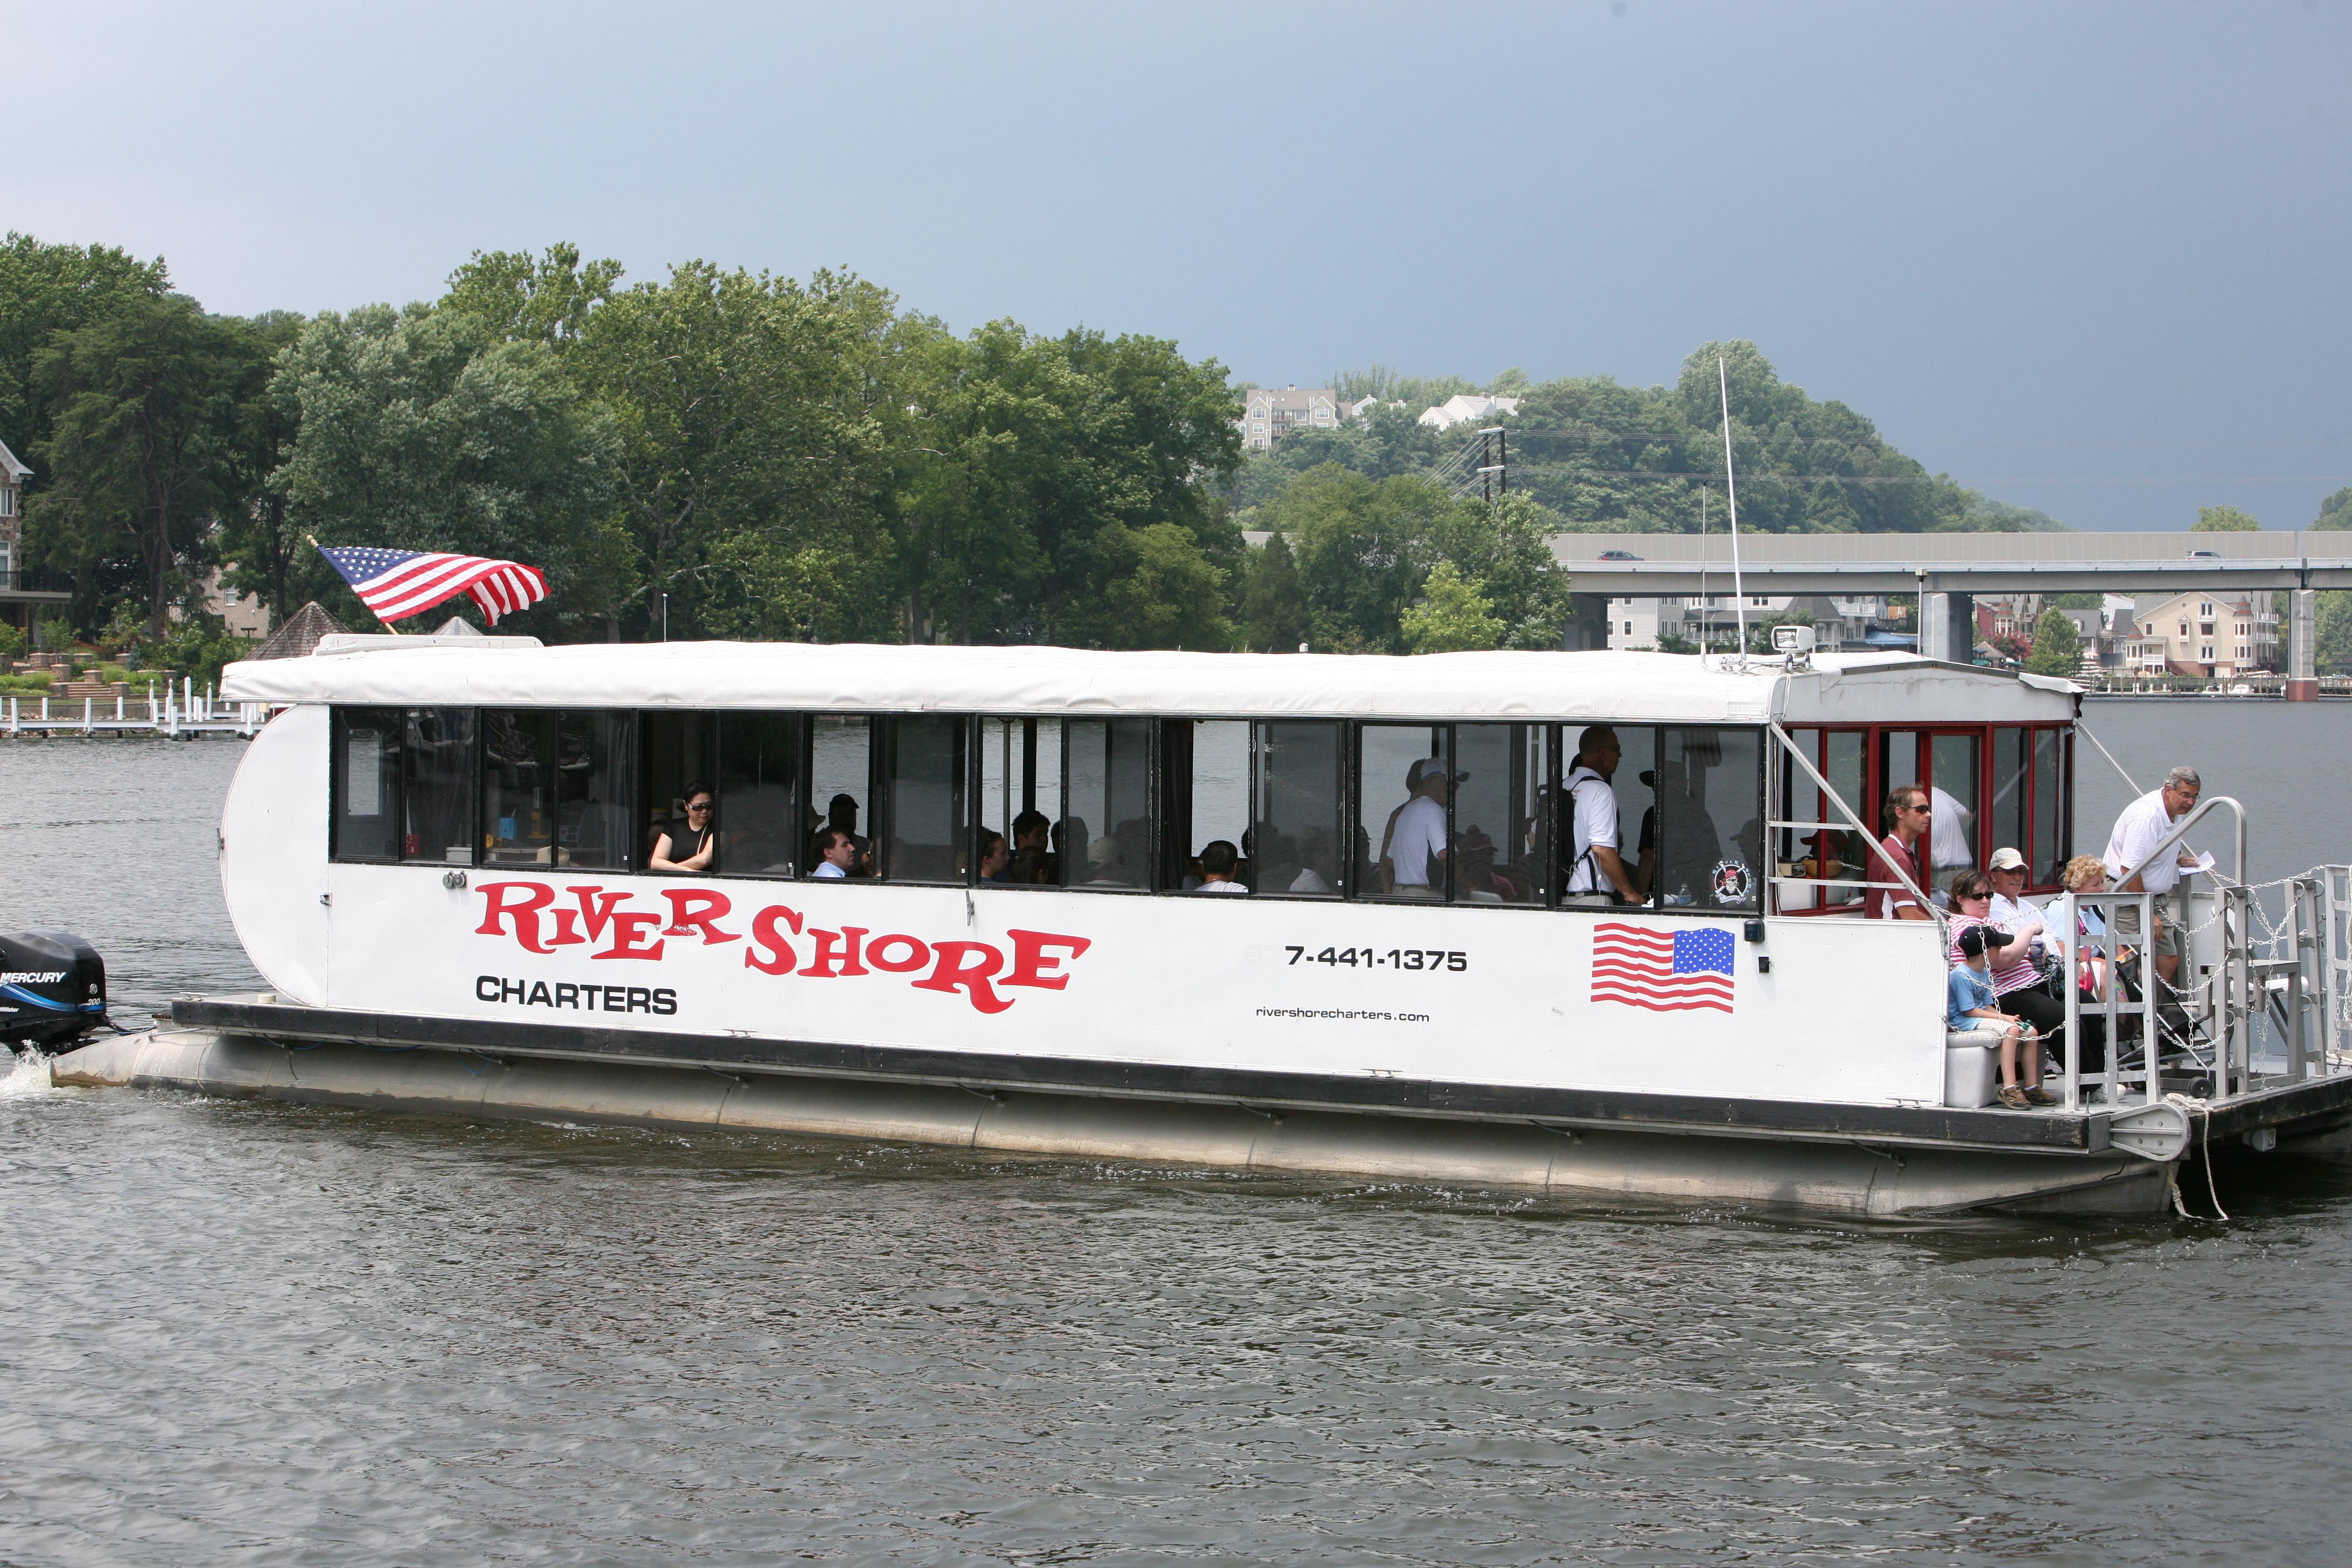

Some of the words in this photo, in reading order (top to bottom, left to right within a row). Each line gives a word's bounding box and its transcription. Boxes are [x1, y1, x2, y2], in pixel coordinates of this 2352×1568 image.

[474, 881, 743, 961] RIVER
[745, 905, 1091, 1014] SHORE
[1285, 946, 1467, 971] 7-441-1375
[0, 972, 66, 983] MERCURY
[87, 998, 101, 1006] 200
[476, 975, 677, 1014] CHARTERS
[1256, 1006, 1430, 1022] rivershorecharters.com
